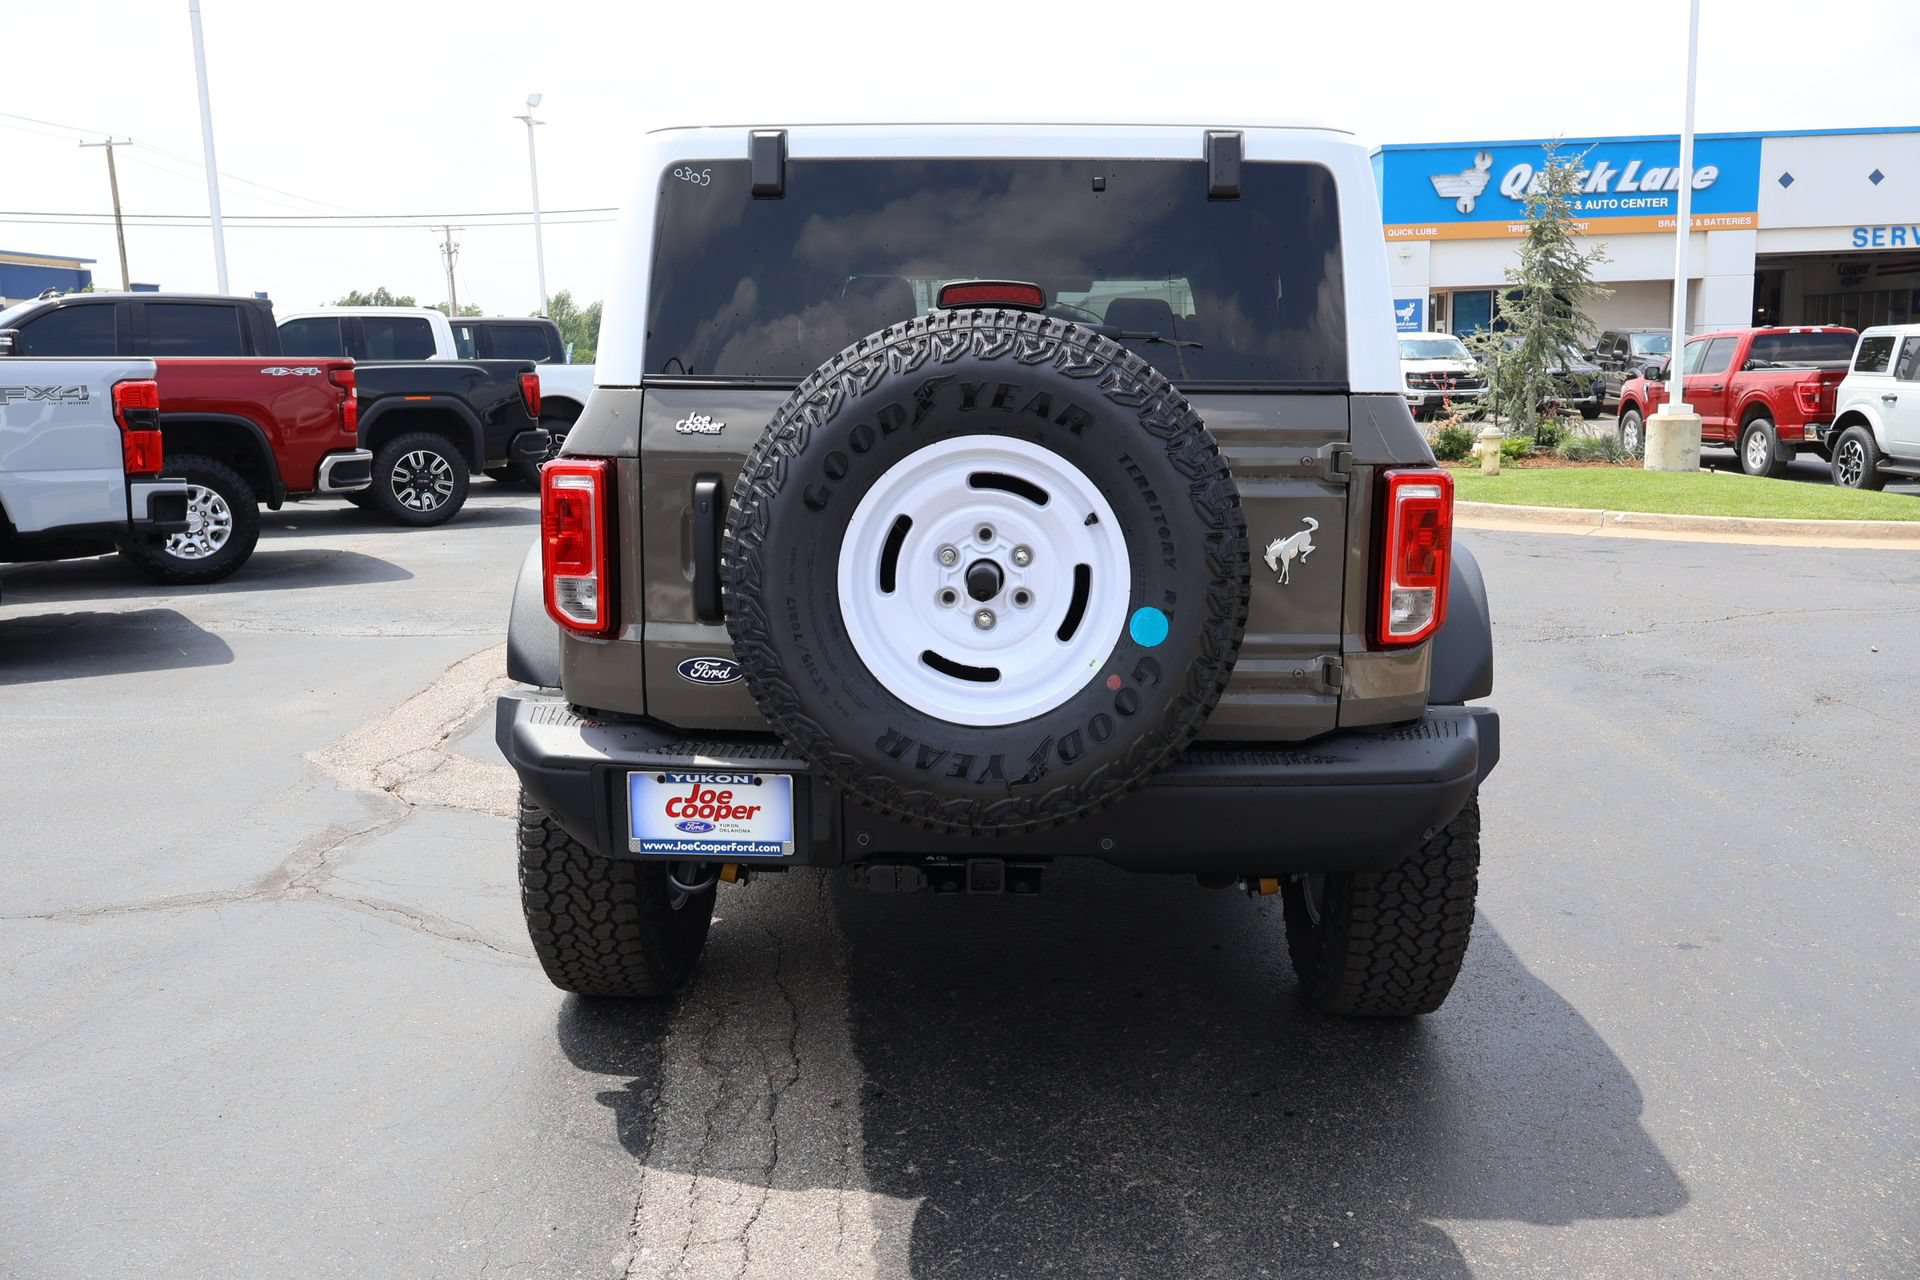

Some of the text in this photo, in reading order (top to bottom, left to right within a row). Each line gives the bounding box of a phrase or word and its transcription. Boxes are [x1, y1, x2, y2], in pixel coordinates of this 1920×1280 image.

[673, 166, 712, 187] 0305
[1584, 199, 1618, 210] AUTO
[1620, 197, 1669, 209] CENTER
[1695, 219, 1702, 227] &
[1703, 216, 1752, 226] BATTERIES
[1387, 227, 1438, 237] QUICK LUBE
[685, 410, 712, 424] Joe
[675, 419, 726, 434] Cooper
[1117, 452, 1178, 571] TERRITORY
[690, 660, 732, 679] Ford
[671, 774, 749, 784] YUKON
[684, 783, 733, 804] Joe
[665, 796, 761, 822] Cooper
[685, 821, 705, 831] Ford
[643, 841, 780, 853] www.JoeCooperFord.com
